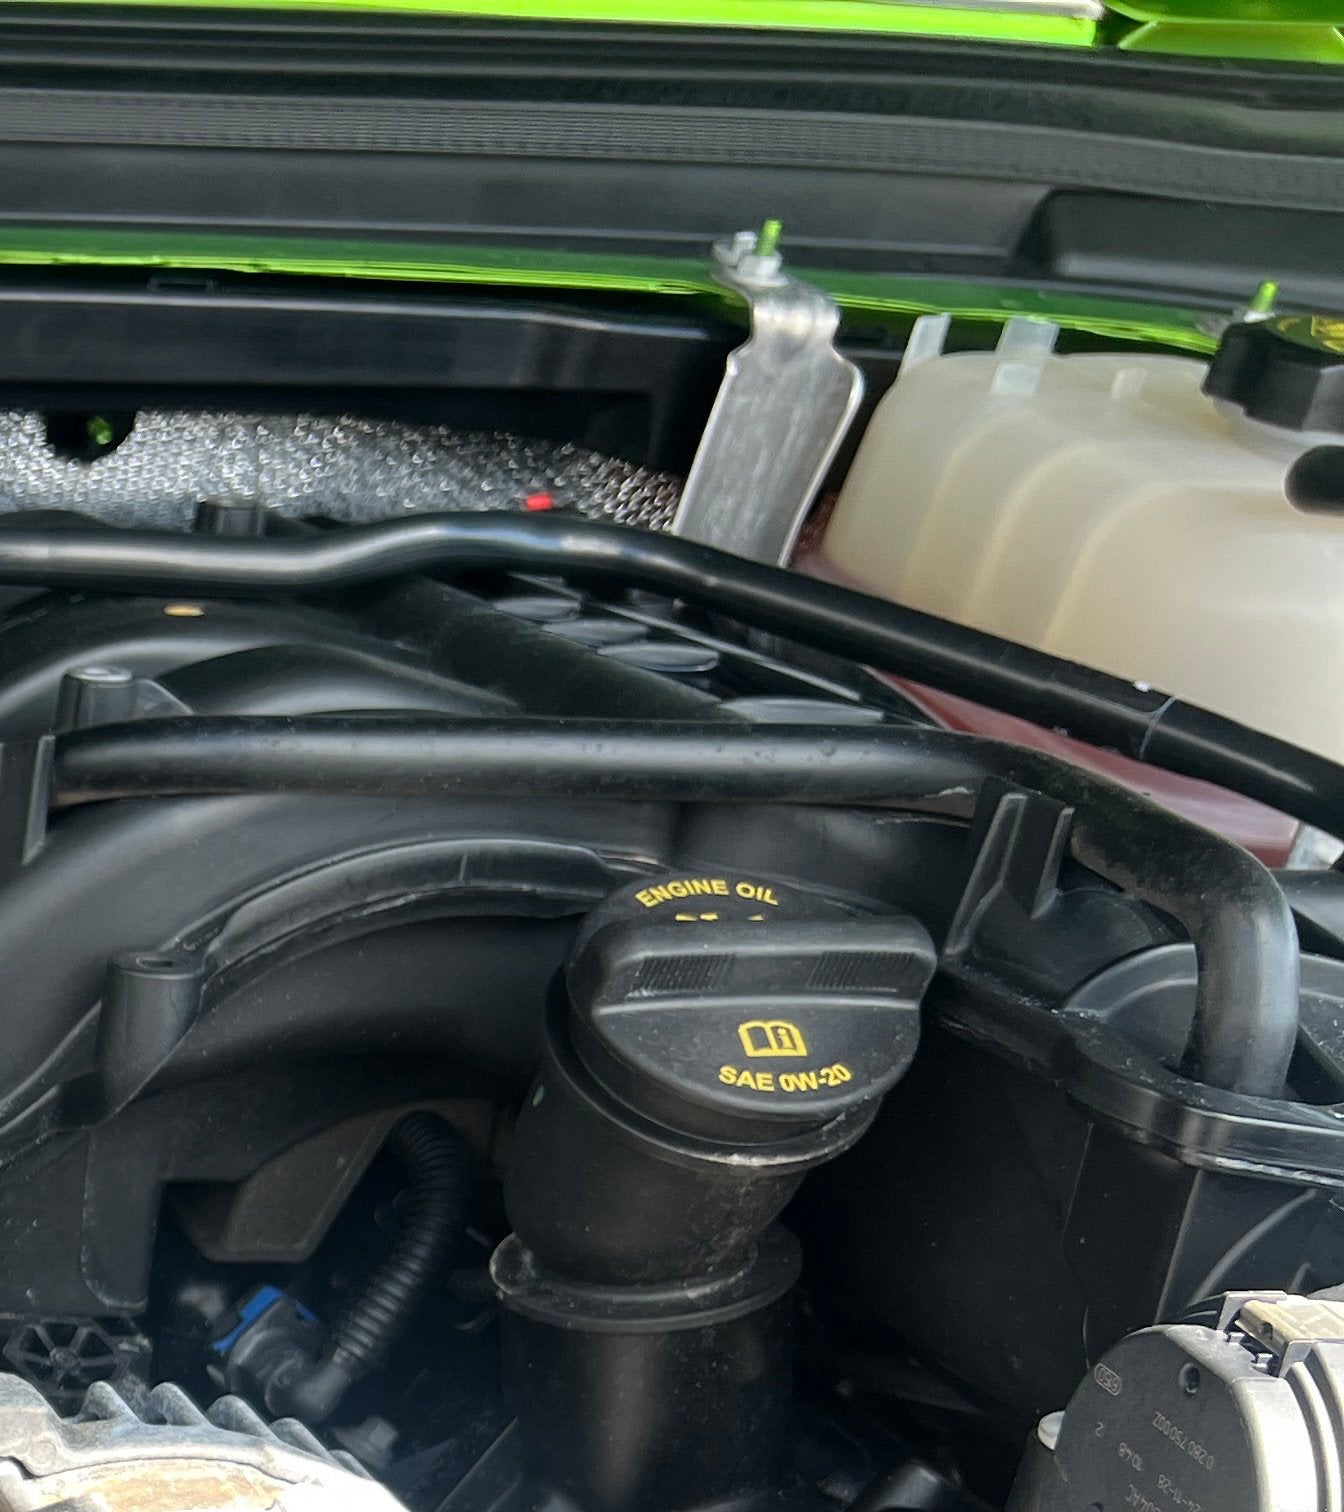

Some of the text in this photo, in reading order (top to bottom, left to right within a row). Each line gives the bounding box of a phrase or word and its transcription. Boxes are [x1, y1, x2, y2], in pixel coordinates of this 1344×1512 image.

[634, 879, 780, 908] ENGINE OIL
[718, 1063, 852, 1093] SAE 0W-20
